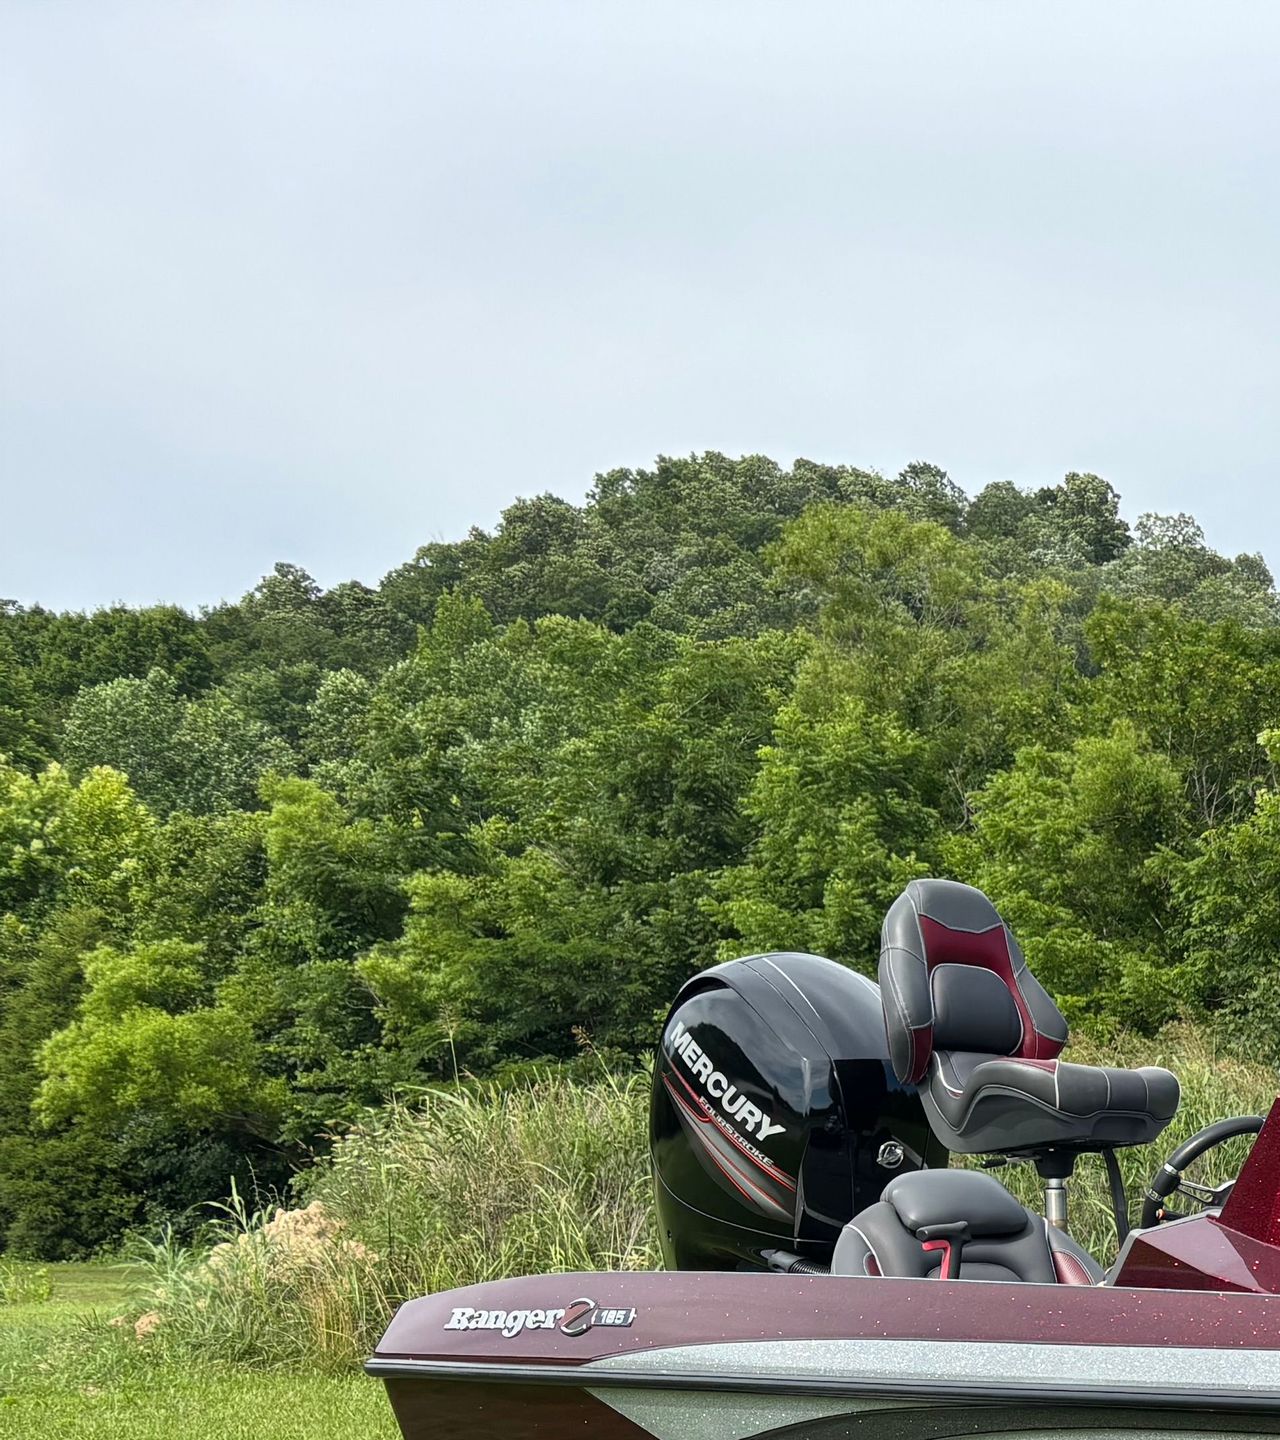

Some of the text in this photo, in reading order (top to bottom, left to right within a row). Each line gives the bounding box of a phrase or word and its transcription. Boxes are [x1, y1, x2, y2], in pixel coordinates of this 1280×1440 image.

[670, 1021, 787, 1142] MERCURY
[700, 1096, 775, 1168] FOURSTROKE
[444, 1307, 566, 1339] Ranger
